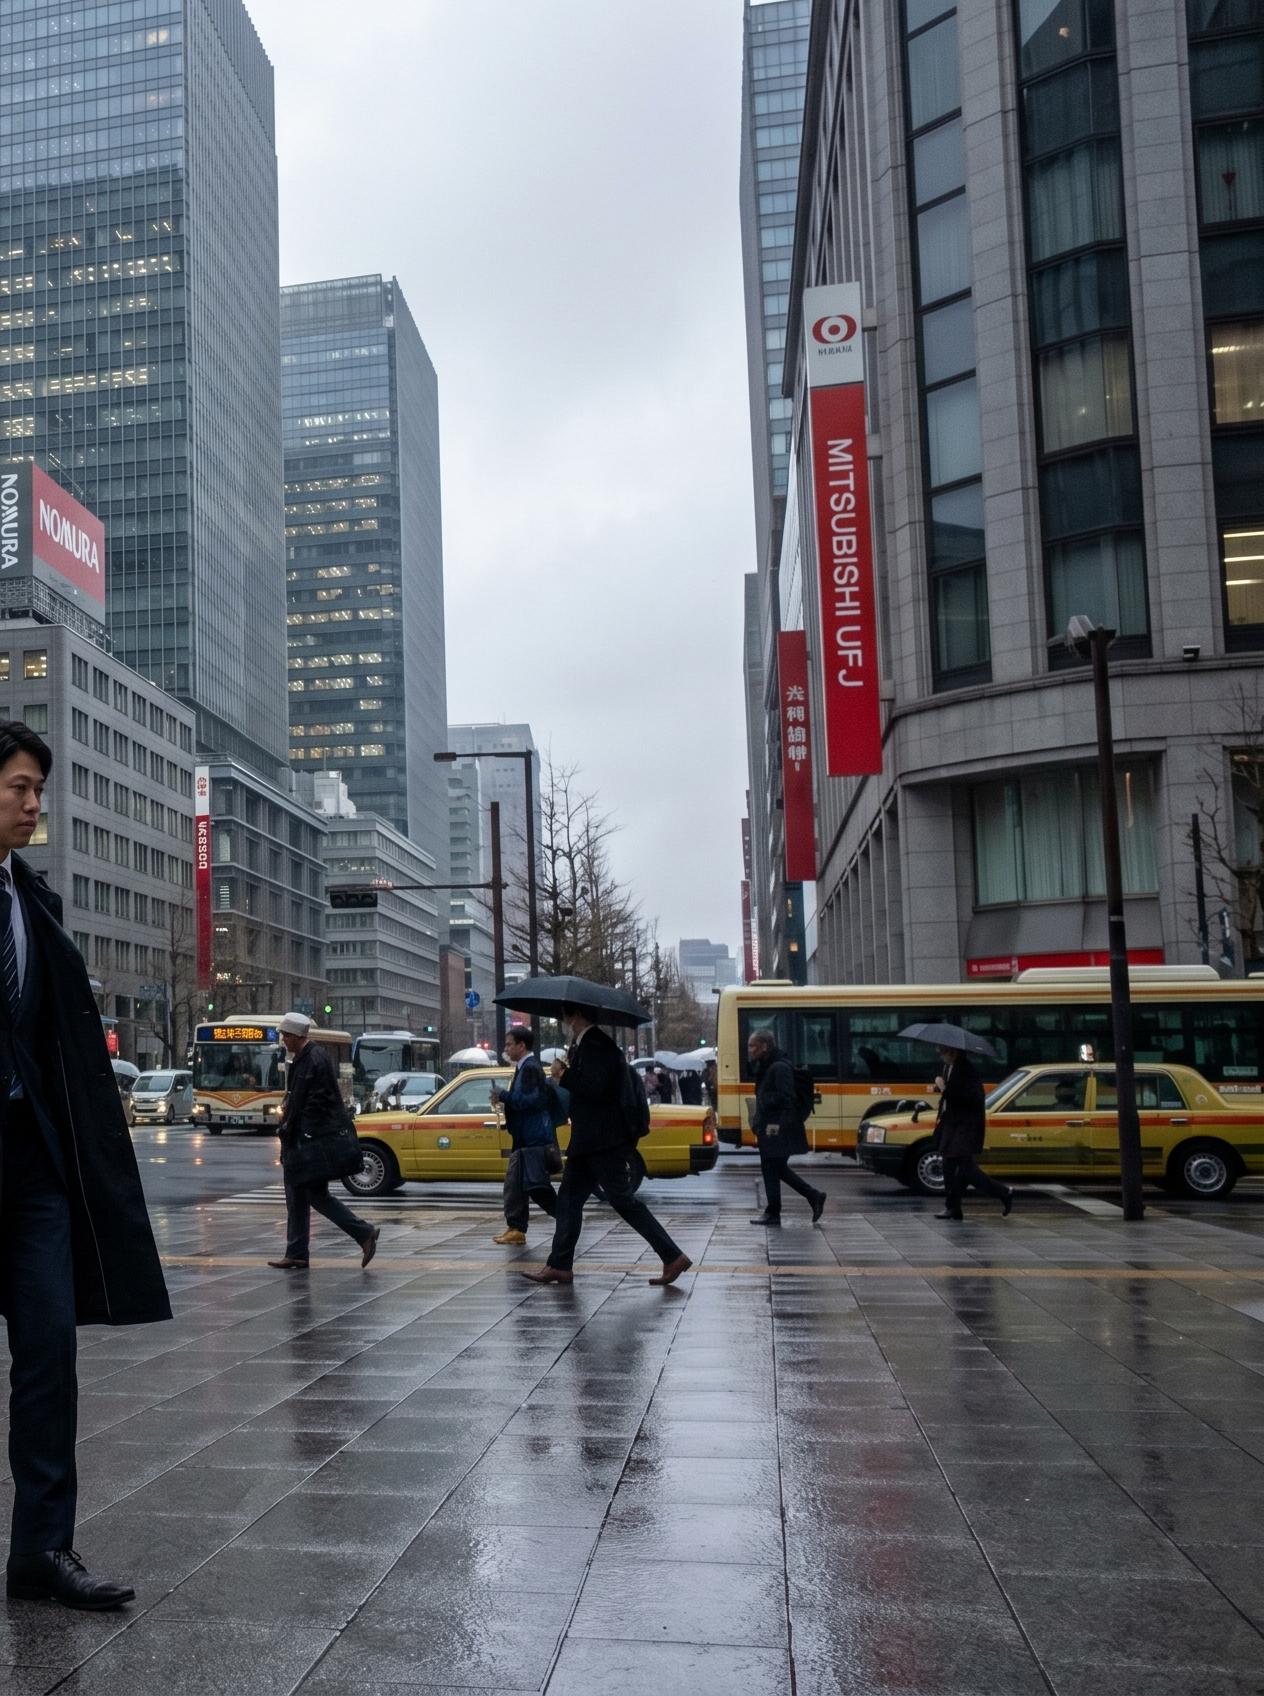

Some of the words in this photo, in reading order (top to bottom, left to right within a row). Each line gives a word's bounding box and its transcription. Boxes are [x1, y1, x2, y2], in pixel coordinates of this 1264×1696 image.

[0, 473, 19, 570] NOMURA
[39, 498, 100, 574] NOMURA
[827, 438, 861, 616] MITSUBISHI
[835, 625, 864, 687] UFJ
